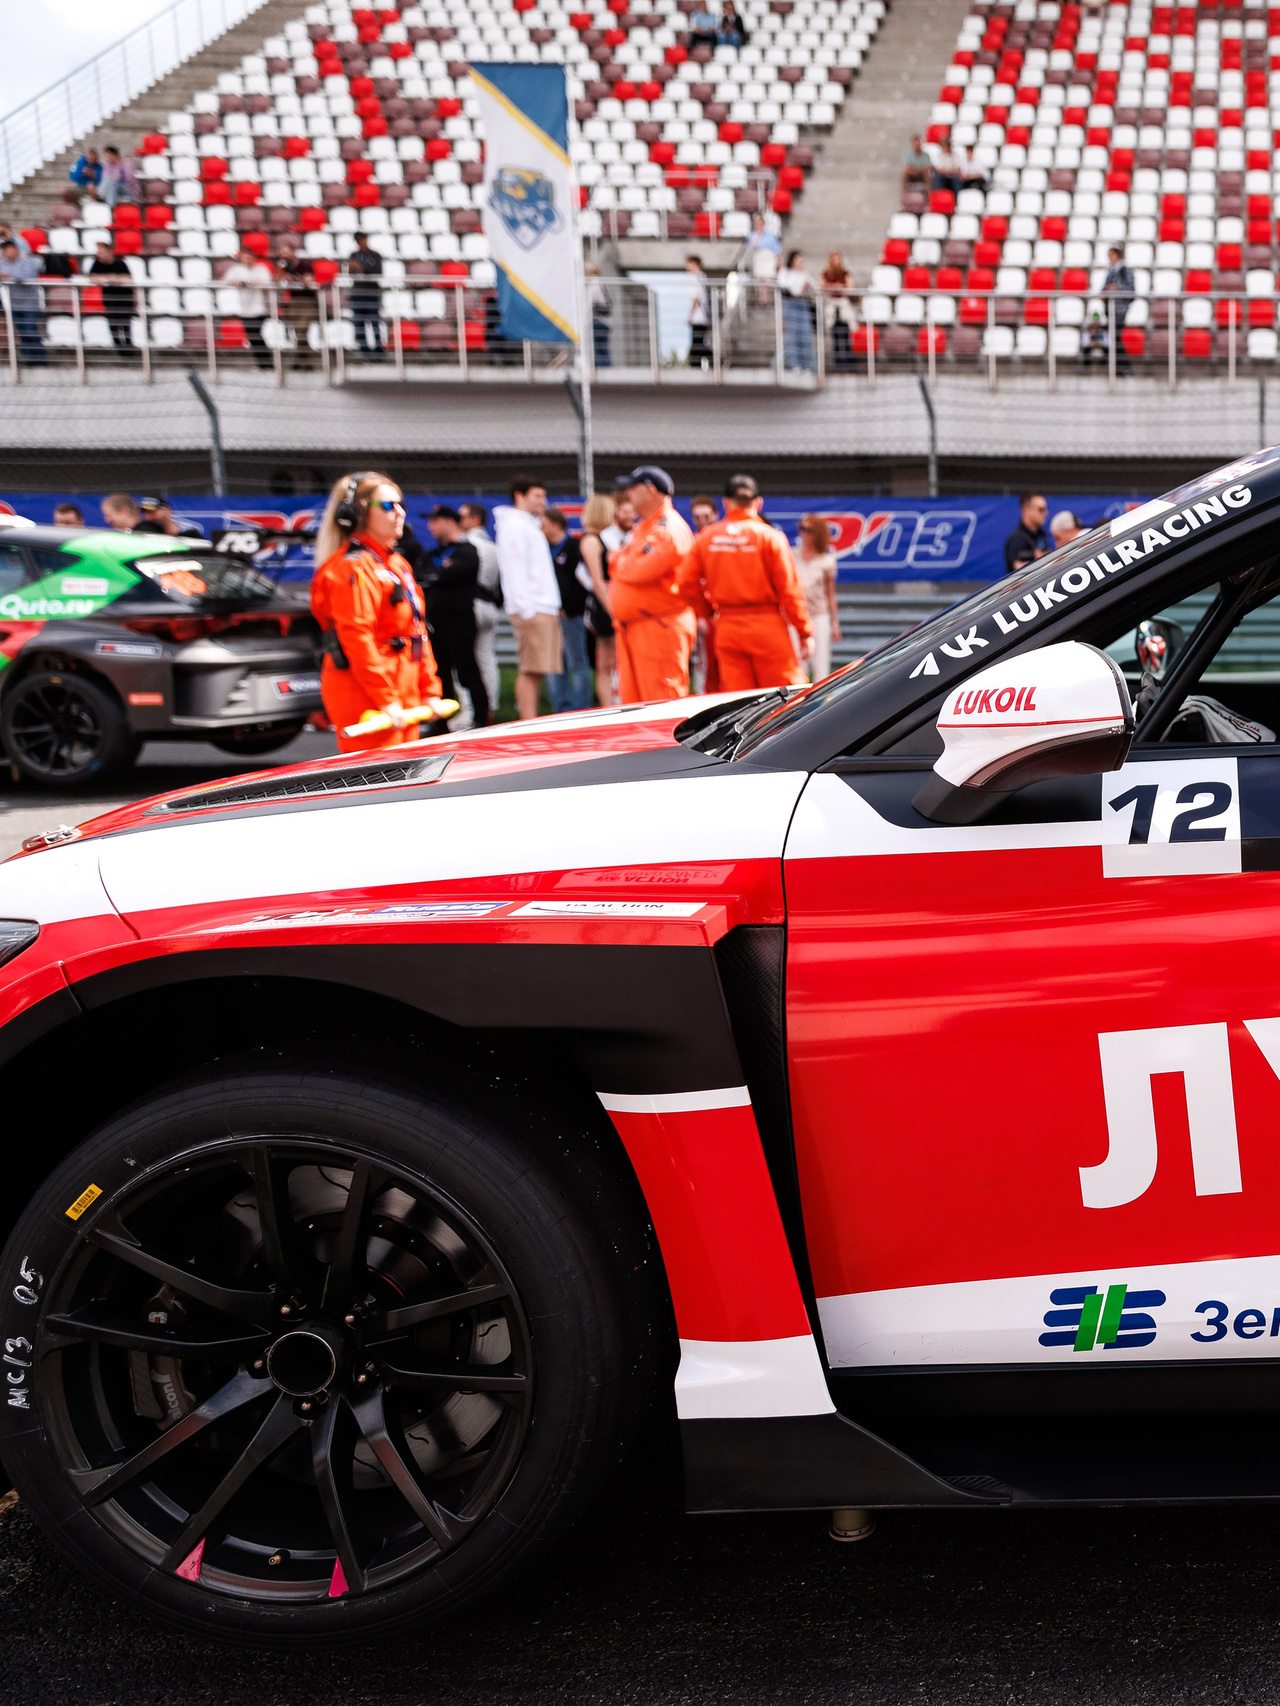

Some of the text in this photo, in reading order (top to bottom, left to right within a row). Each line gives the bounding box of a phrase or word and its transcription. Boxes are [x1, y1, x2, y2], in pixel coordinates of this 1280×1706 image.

[992, 484, 1252, 635] LUKOILRACING
[953, 686, 1036, 716] LUKOIL
[1108, 782, 1233, 845] 12
